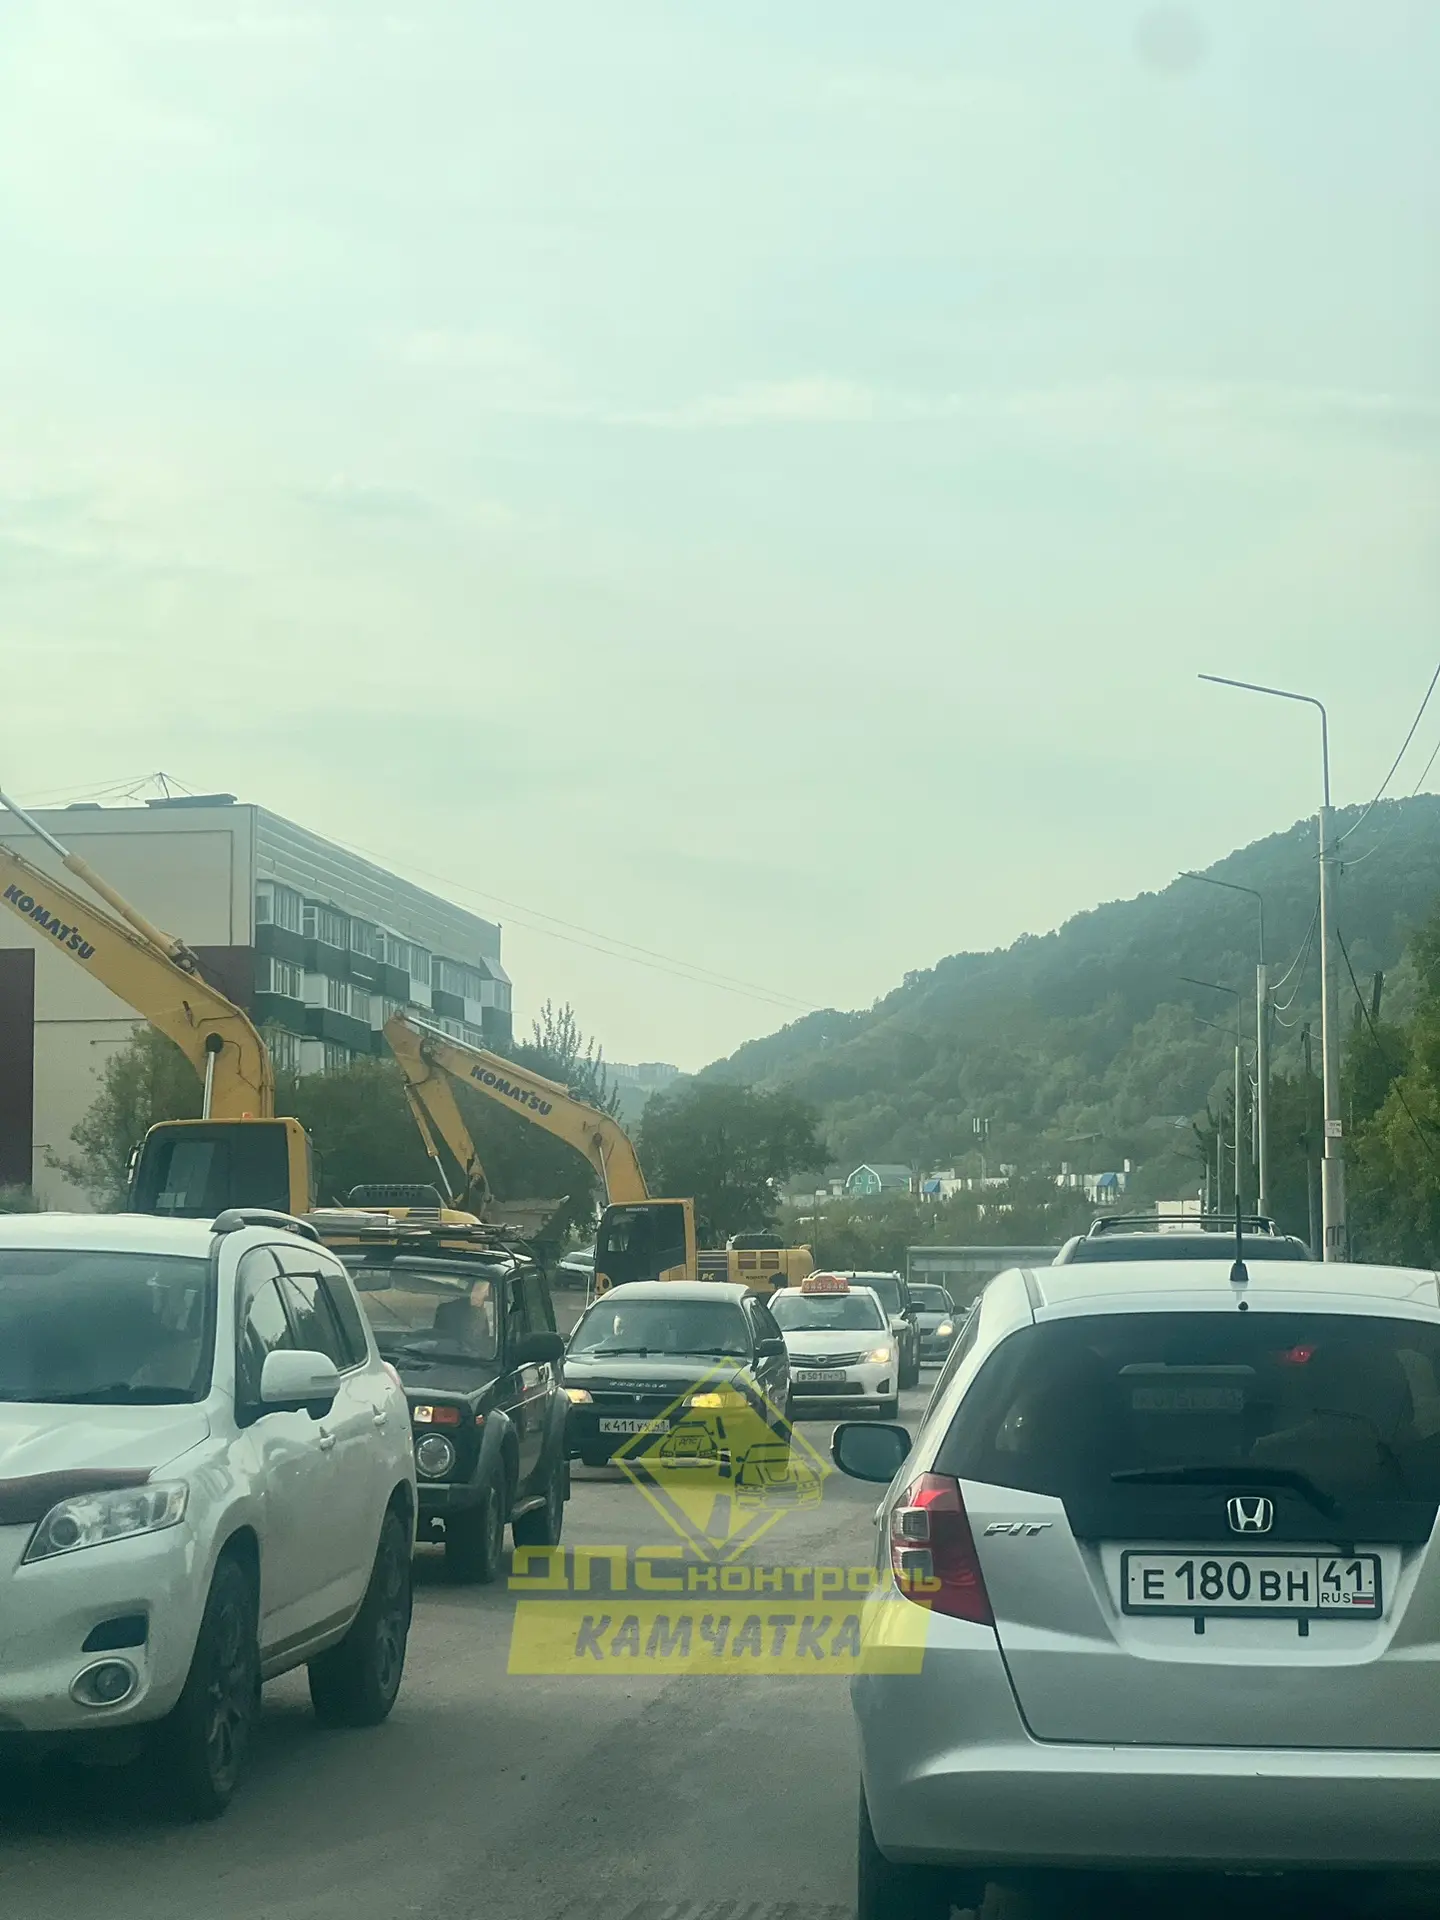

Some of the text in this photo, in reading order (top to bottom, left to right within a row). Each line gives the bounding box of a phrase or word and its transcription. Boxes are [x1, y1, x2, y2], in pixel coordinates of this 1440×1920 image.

[3, 884, 96, 959] KOMATSU
[470, 1065, 553, 1116] KOMATSU
[984, 1522, 1053, 1537] FIT
[1321, 1592, 1351, 1603] RUS
